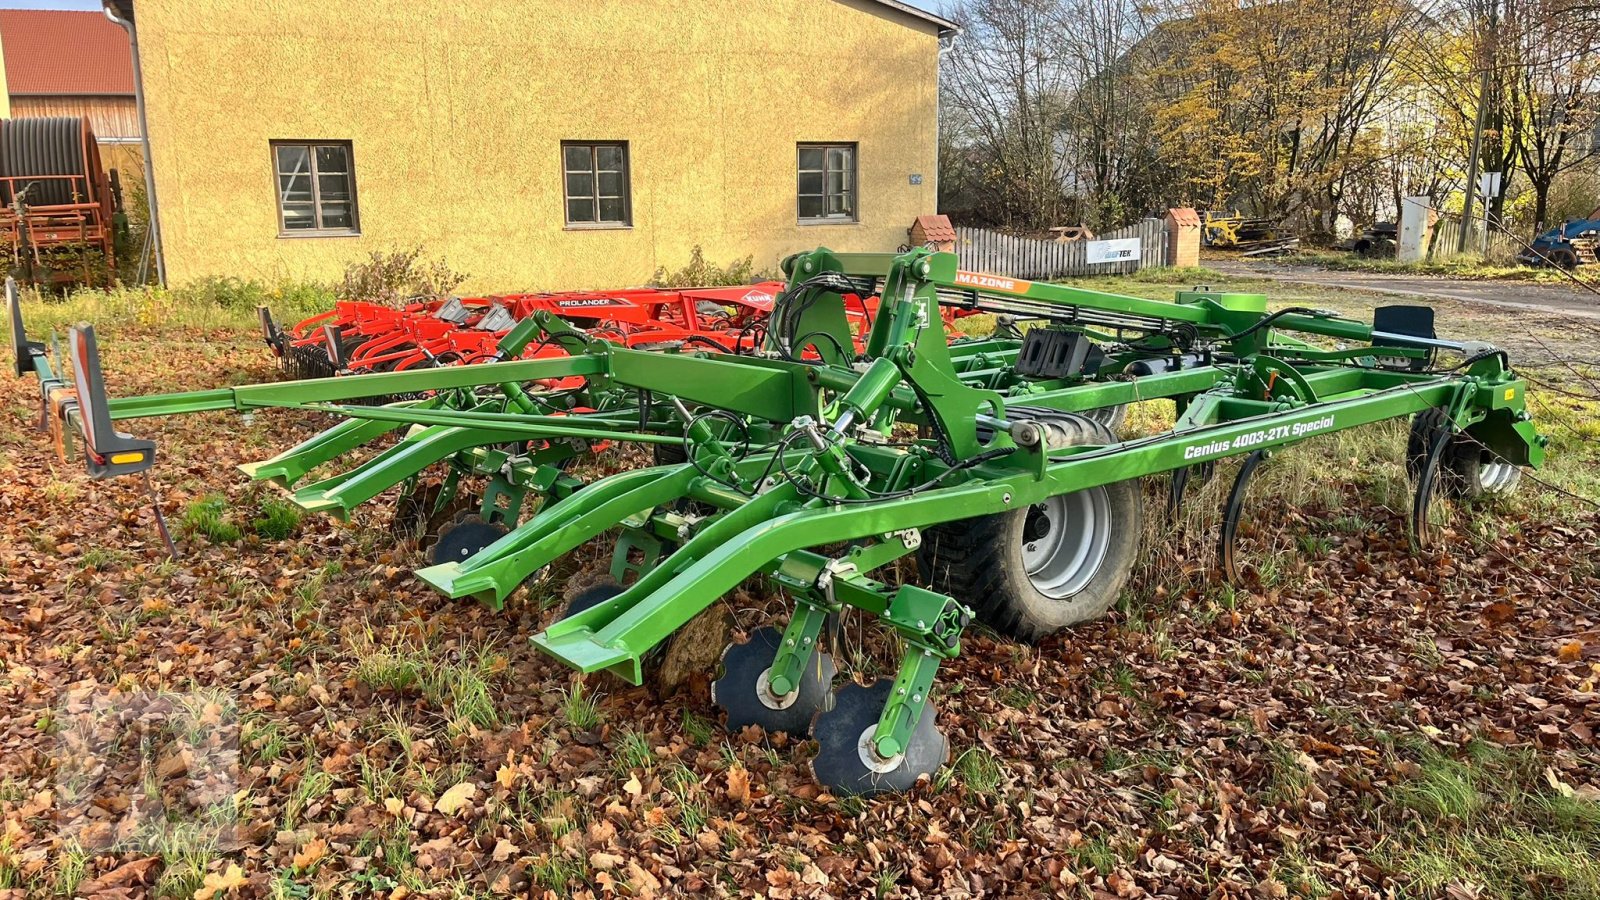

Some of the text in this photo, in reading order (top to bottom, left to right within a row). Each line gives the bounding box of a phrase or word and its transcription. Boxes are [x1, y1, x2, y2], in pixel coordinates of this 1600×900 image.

[1184, 414, 1335, 459] Cenius 4003-2TX Special
